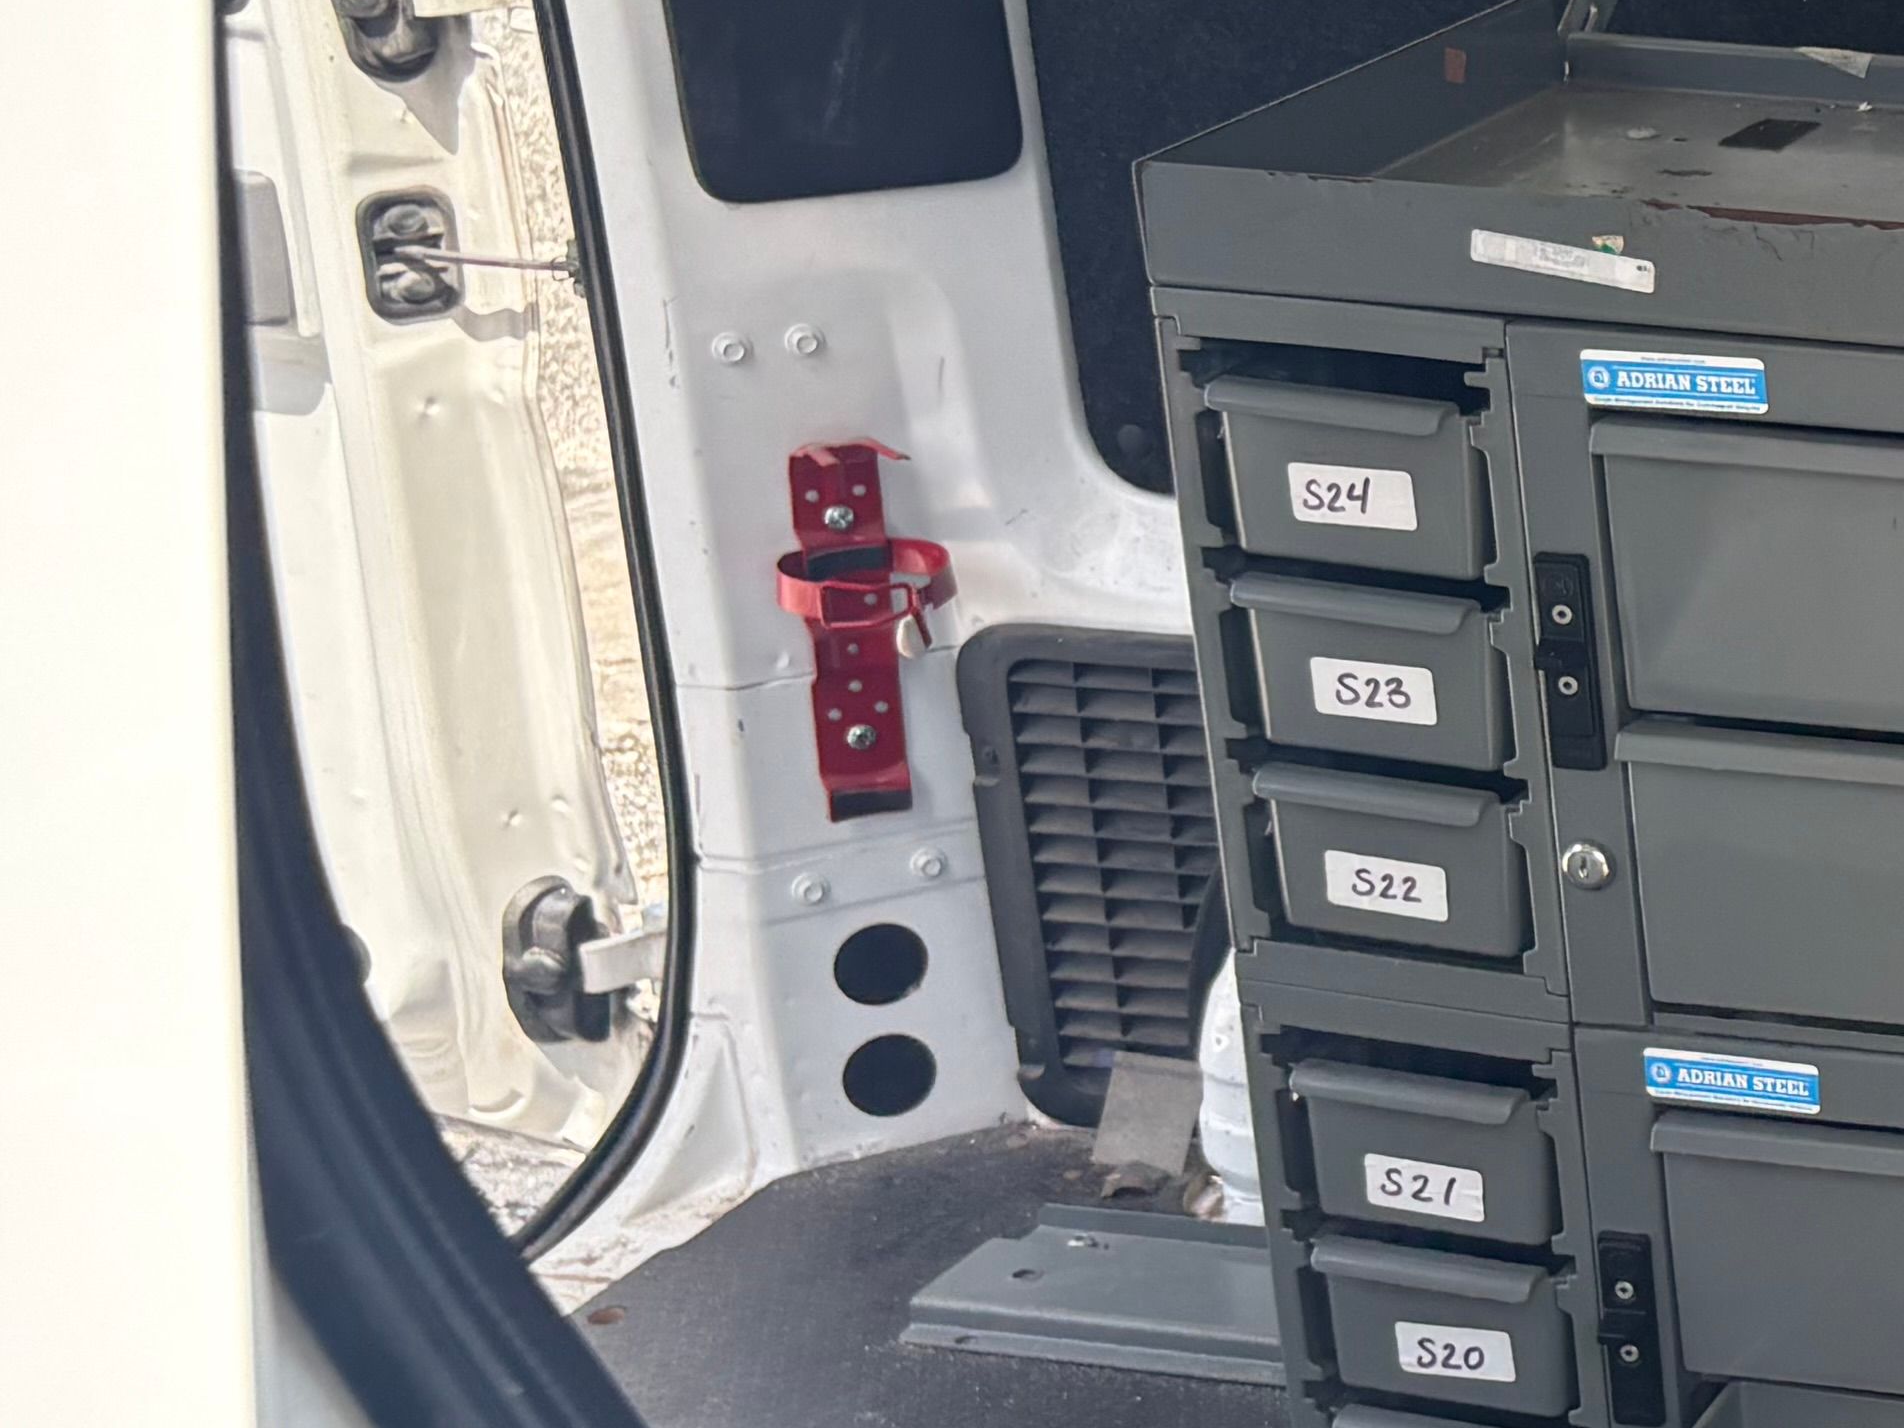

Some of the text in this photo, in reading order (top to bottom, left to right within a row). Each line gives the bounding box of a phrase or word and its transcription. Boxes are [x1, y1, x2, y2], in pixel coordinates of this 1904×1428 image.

[1616, 370, 1756, 395] ADRIAN STEEL
[1302, 477, 1370, 513] S24
[1335, 673, 1411, 708] S23
[1351, 868, 1418, 903] S22
[1677, 1067, 1809, 1097] ADRIAN STEEL
[1380, 1168, 1457, 1205] S21
[1416, 1337, 1484, 1370] S20
